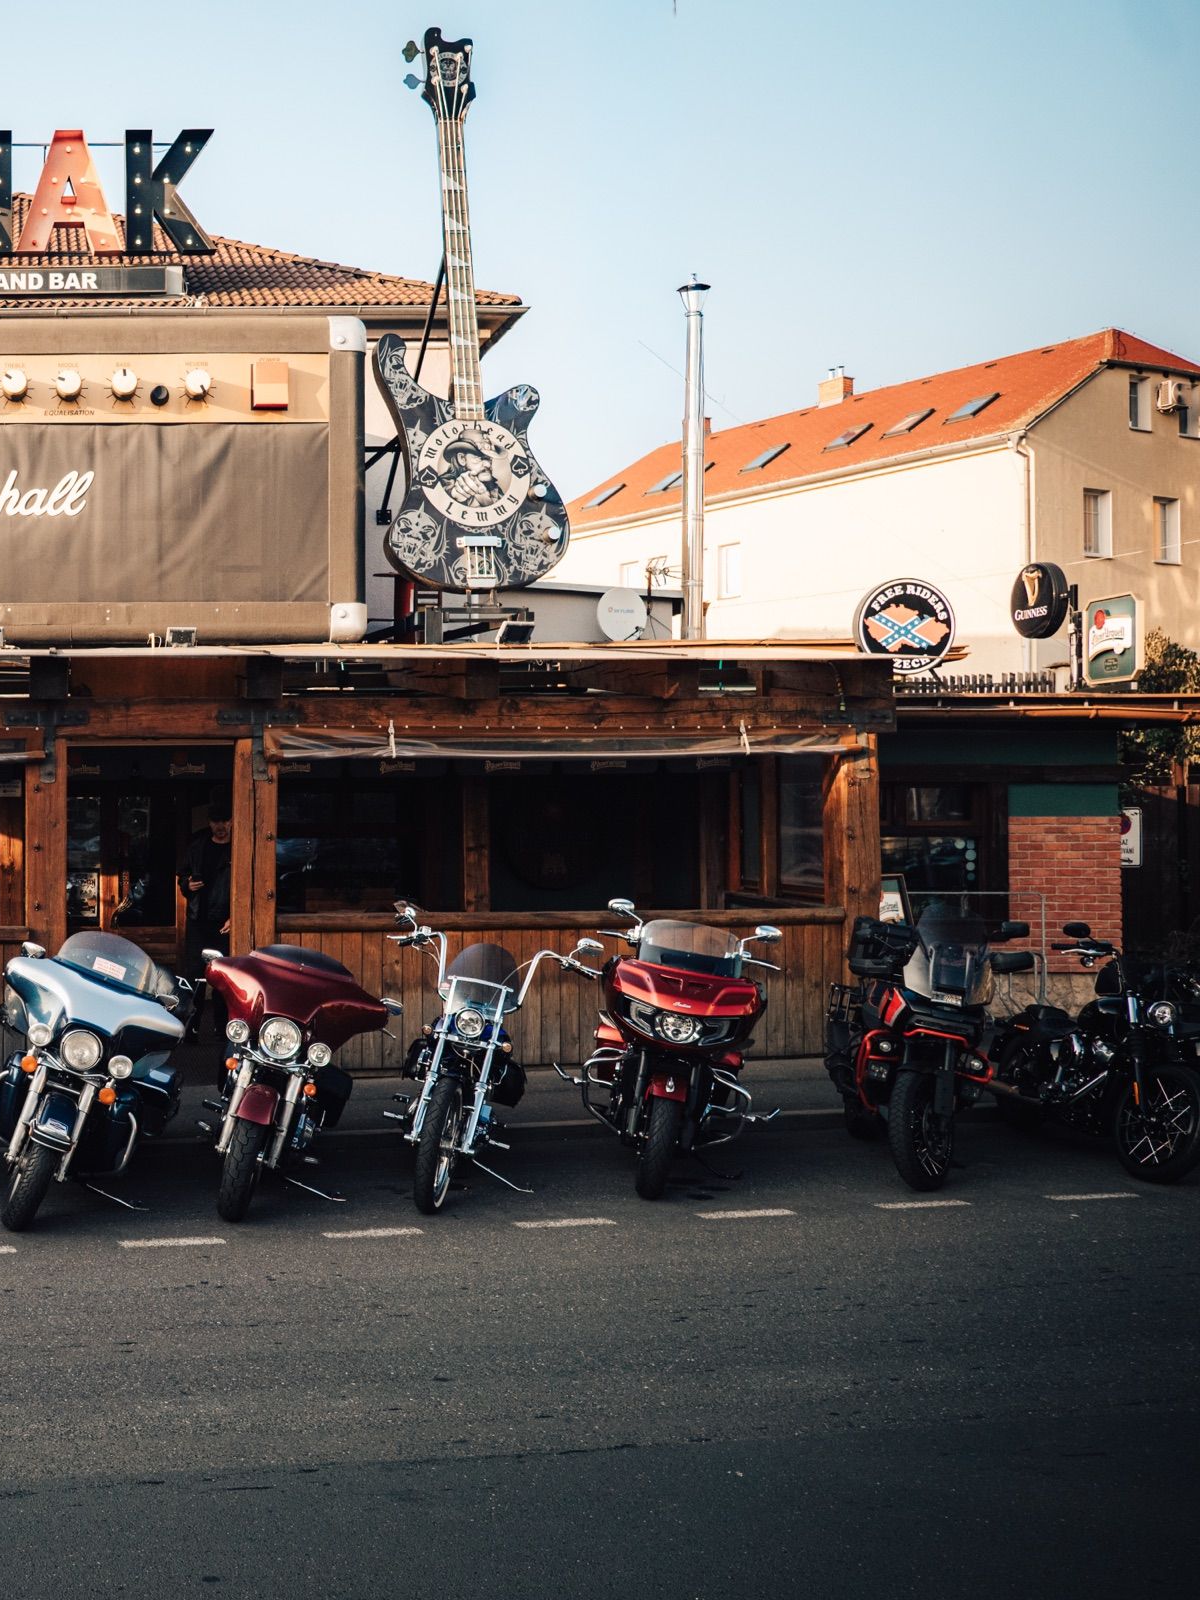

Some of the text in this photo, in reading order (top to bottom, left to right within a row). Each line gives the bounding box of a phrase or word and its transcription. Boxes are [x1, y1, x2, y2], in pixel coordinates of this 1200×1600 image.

[49, 272, 98, 290] BAR
[446, 494, 519, 521] Lemmy
[871, 584, 948, 620] FREE RIDERS
[892, 656, 931, 669] ZECH
